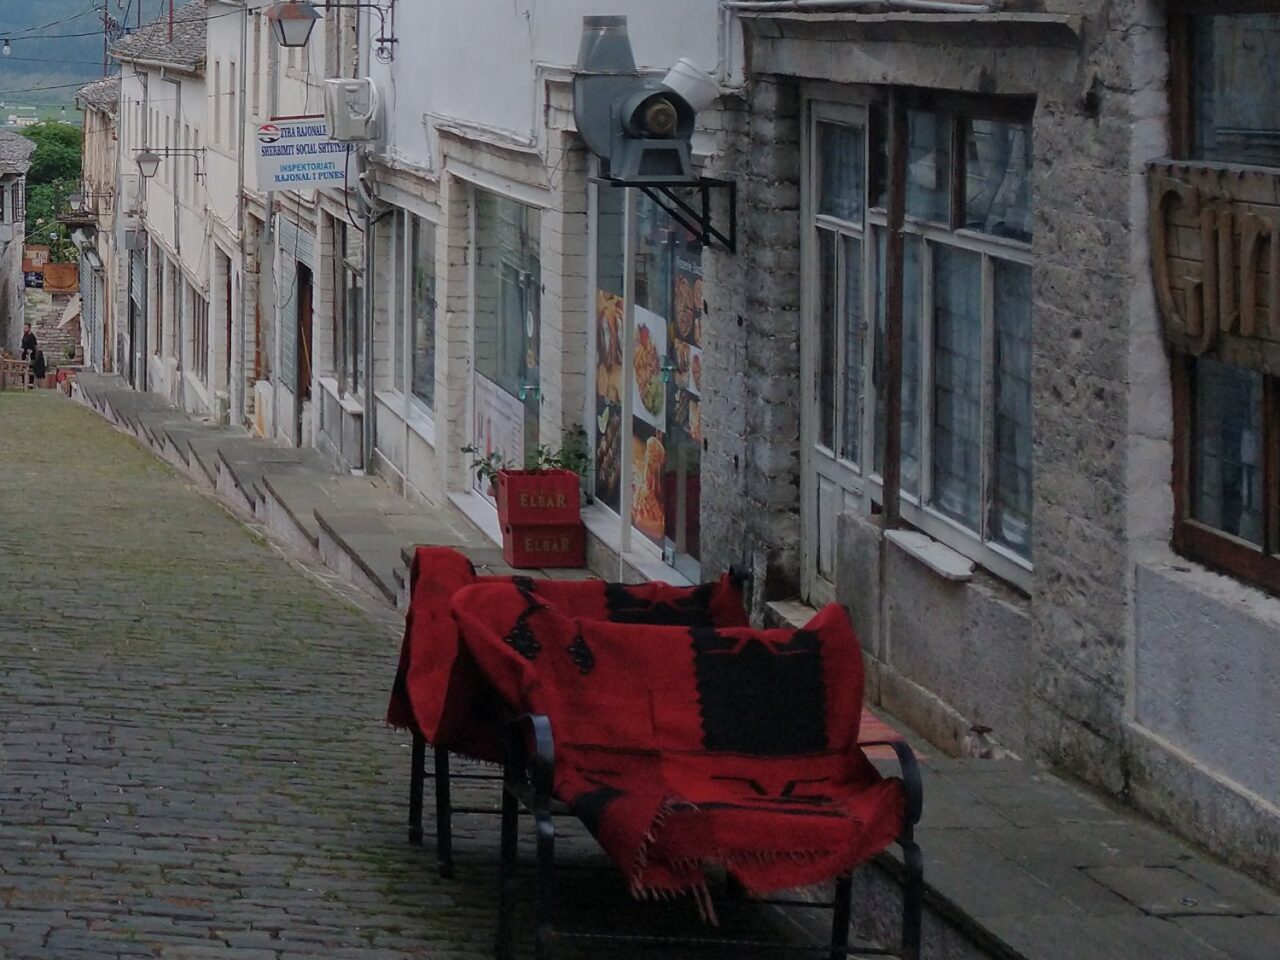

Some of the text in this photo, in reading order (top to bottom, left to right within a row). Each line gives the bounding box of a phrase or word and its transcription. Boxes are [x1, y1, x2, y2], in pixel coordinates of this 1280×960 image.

[296, 143, 317, 155] SOCIAL
[280, 162, 335, 172] INSPEKTORIATI
[275, 173, 311, 182] RAJONAL
[318, 170, 345, 181] PUNES
[519, 493, 567, 508] ELBAR
[524, 538, 571, 552] ELBAR
